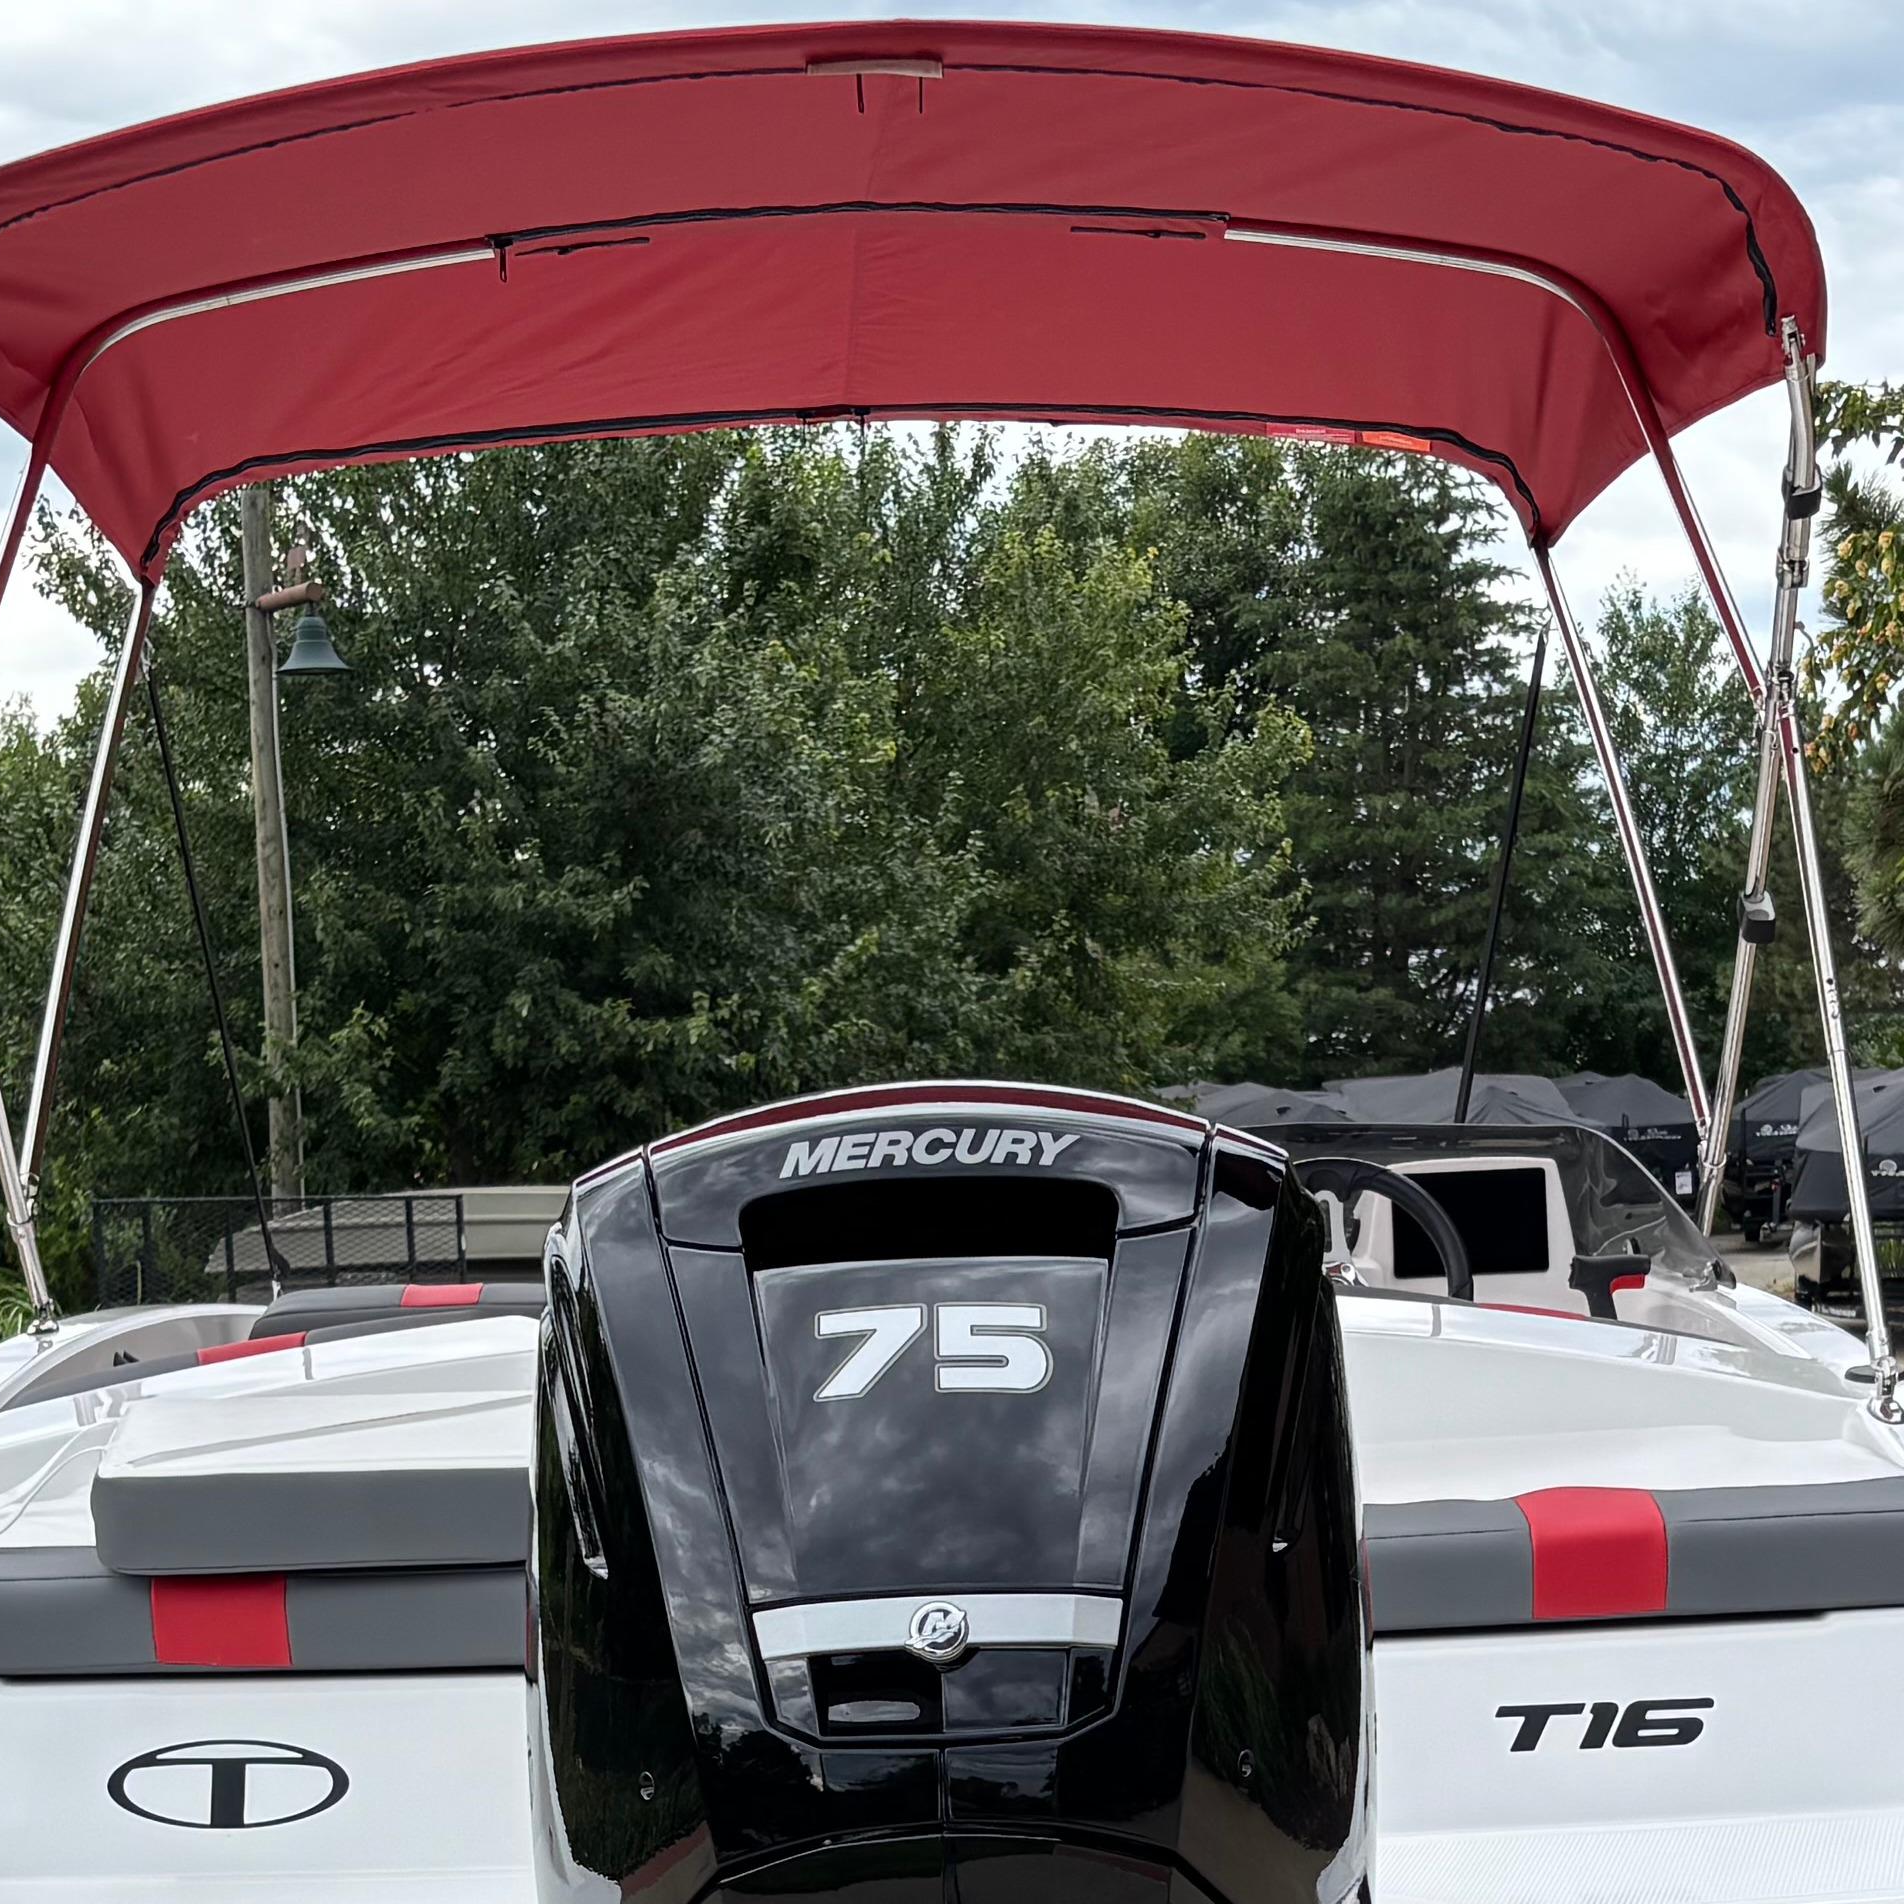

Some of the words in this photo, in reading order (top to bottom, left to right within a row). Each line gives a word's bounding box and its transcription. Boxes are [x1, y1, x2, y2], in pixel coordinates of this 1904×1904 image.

[779, 1128, 1081, 1179] MERCURY
[813, 1302, 1054, 1402] 75
[1495, 1697, 1715, 1752] T16
